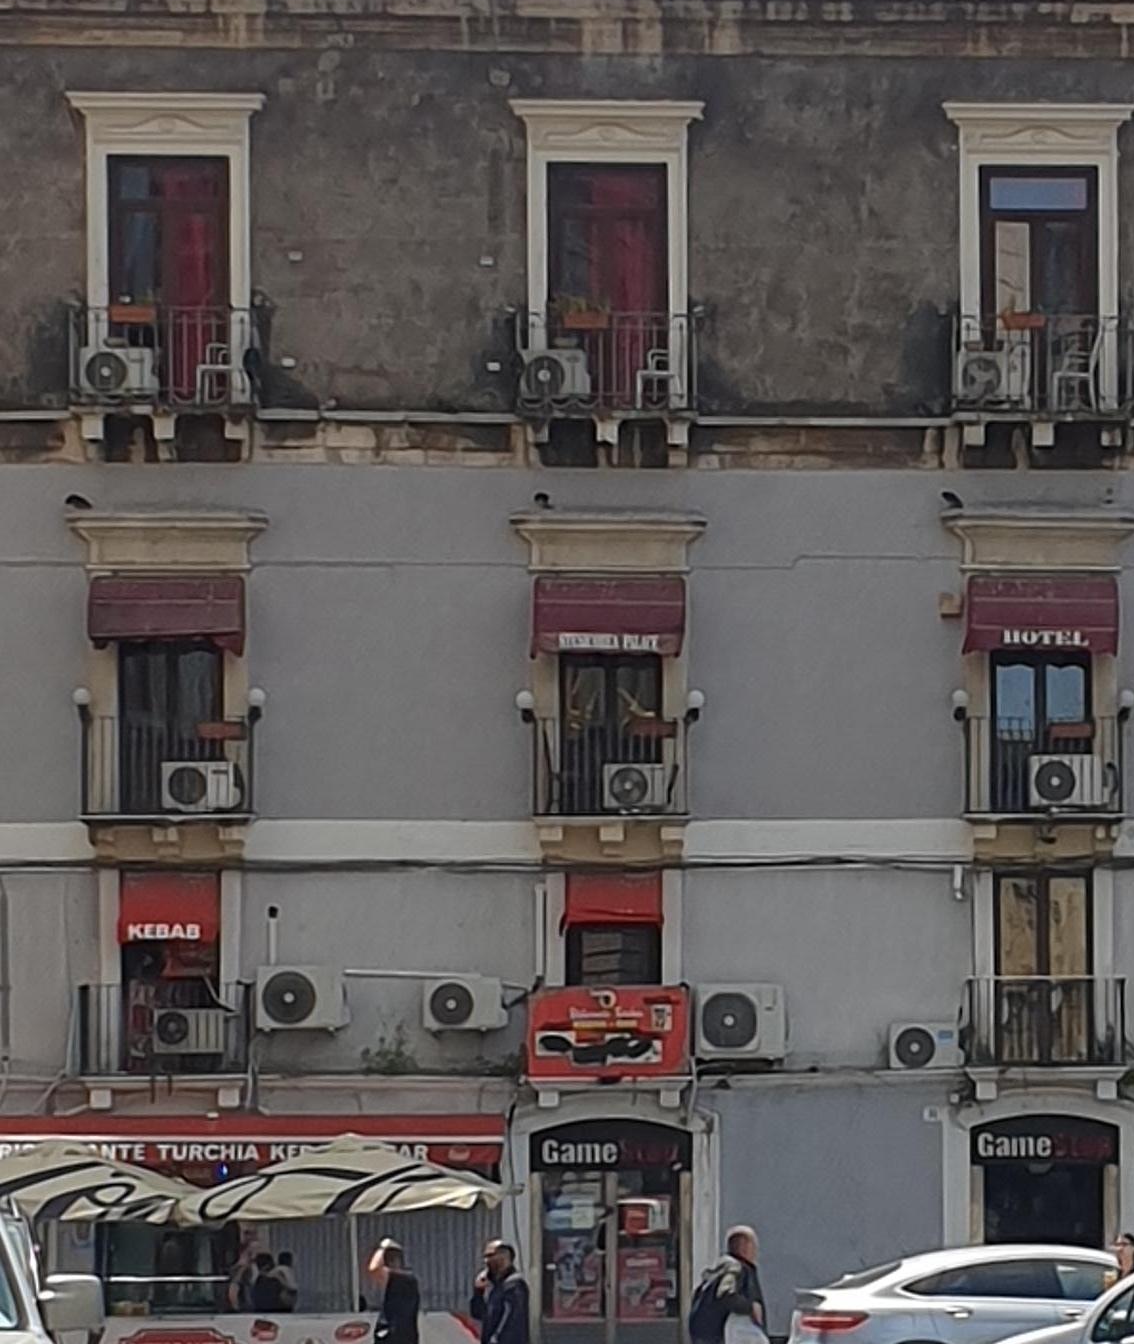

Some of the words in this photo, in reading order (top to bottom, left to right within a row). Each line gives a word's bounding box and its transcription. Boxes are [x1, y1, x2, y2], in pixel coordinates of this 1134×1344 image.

[1002, 629, 1090, 647] HOTEL
[127, 922, 201, 941] KEBAB
[156, 1143, 260, 1161] TURCHIA
